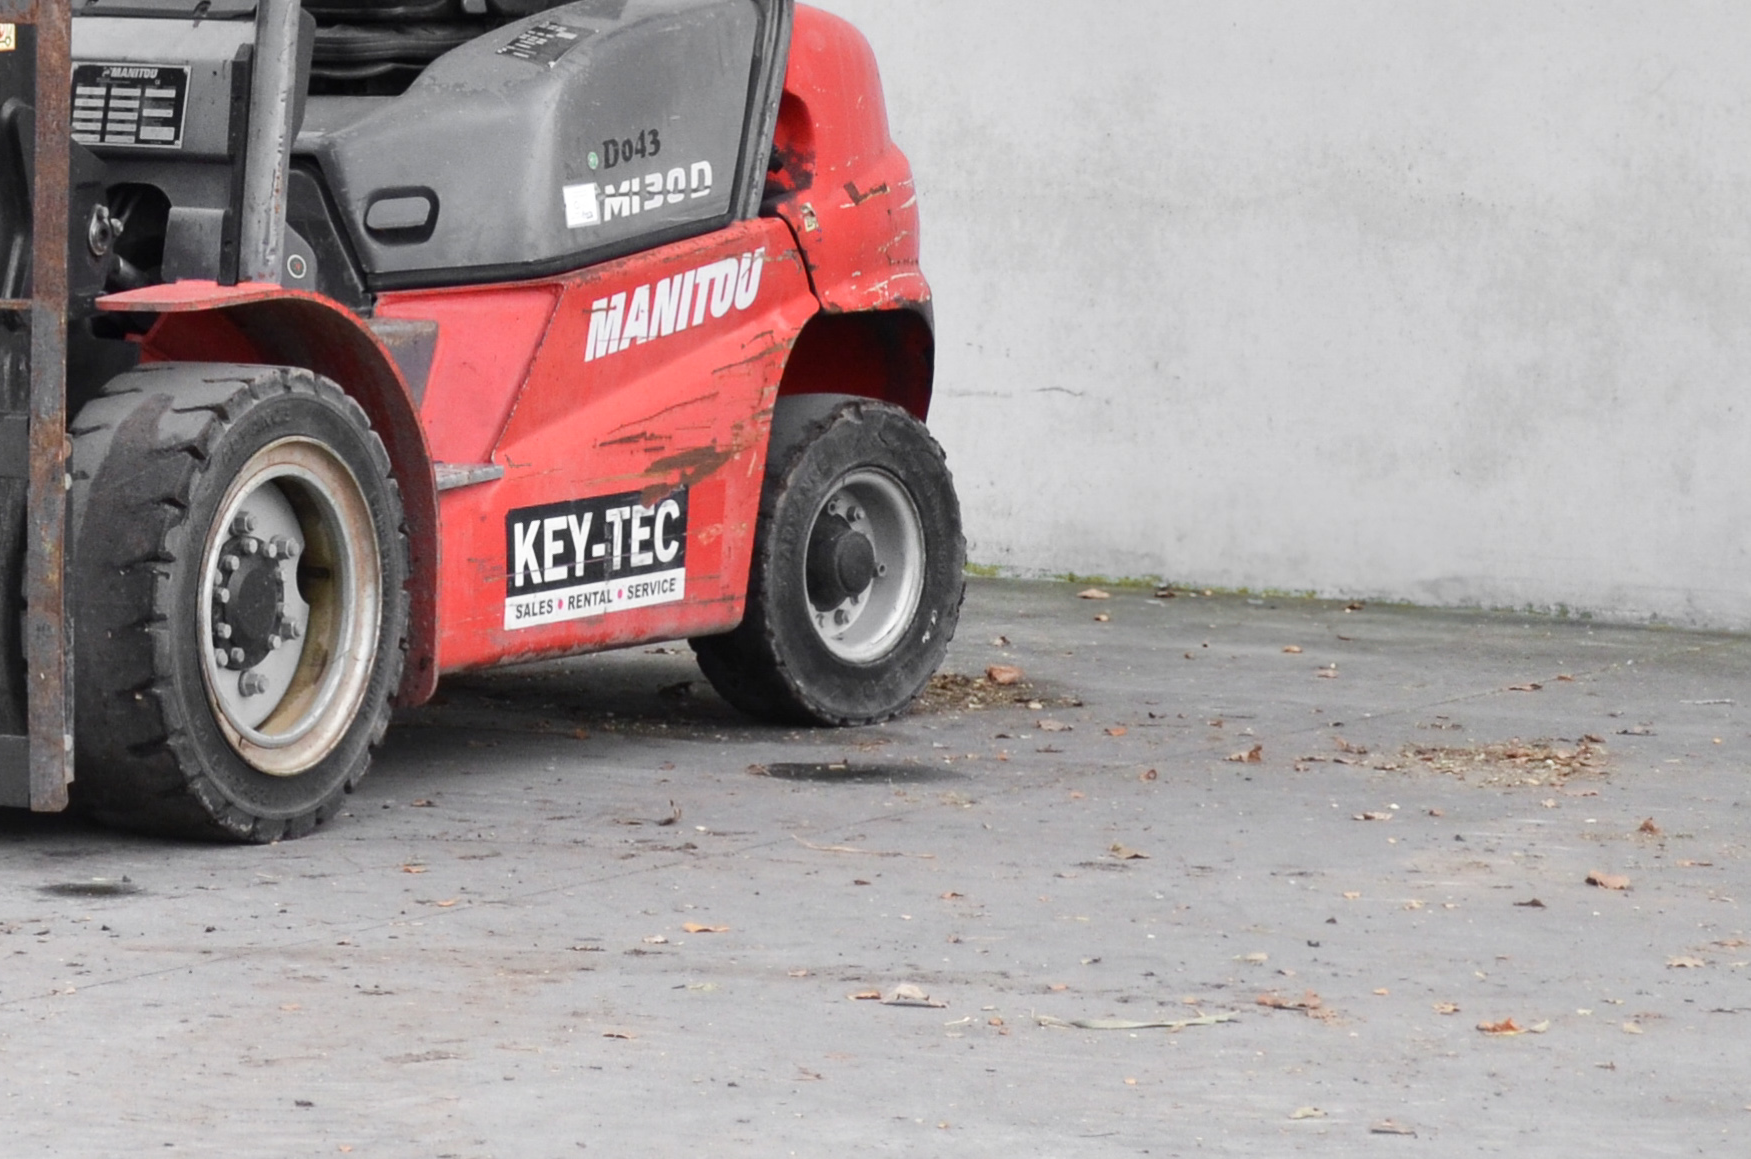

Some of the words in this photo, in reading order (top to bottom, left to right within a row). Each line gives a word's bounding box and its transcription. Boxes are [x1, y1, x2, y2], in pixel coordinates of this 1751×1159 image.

[110, 66, 159, 79] MANITOU
[584, 246, 765, 362] MANITOU
[514, 499, 681, 588] KEY-TEC
[515, 599, 554, 620] SALES
[567, 589, 613, 611] RENTAL
[627, 577, 676, 600] SERVICE
